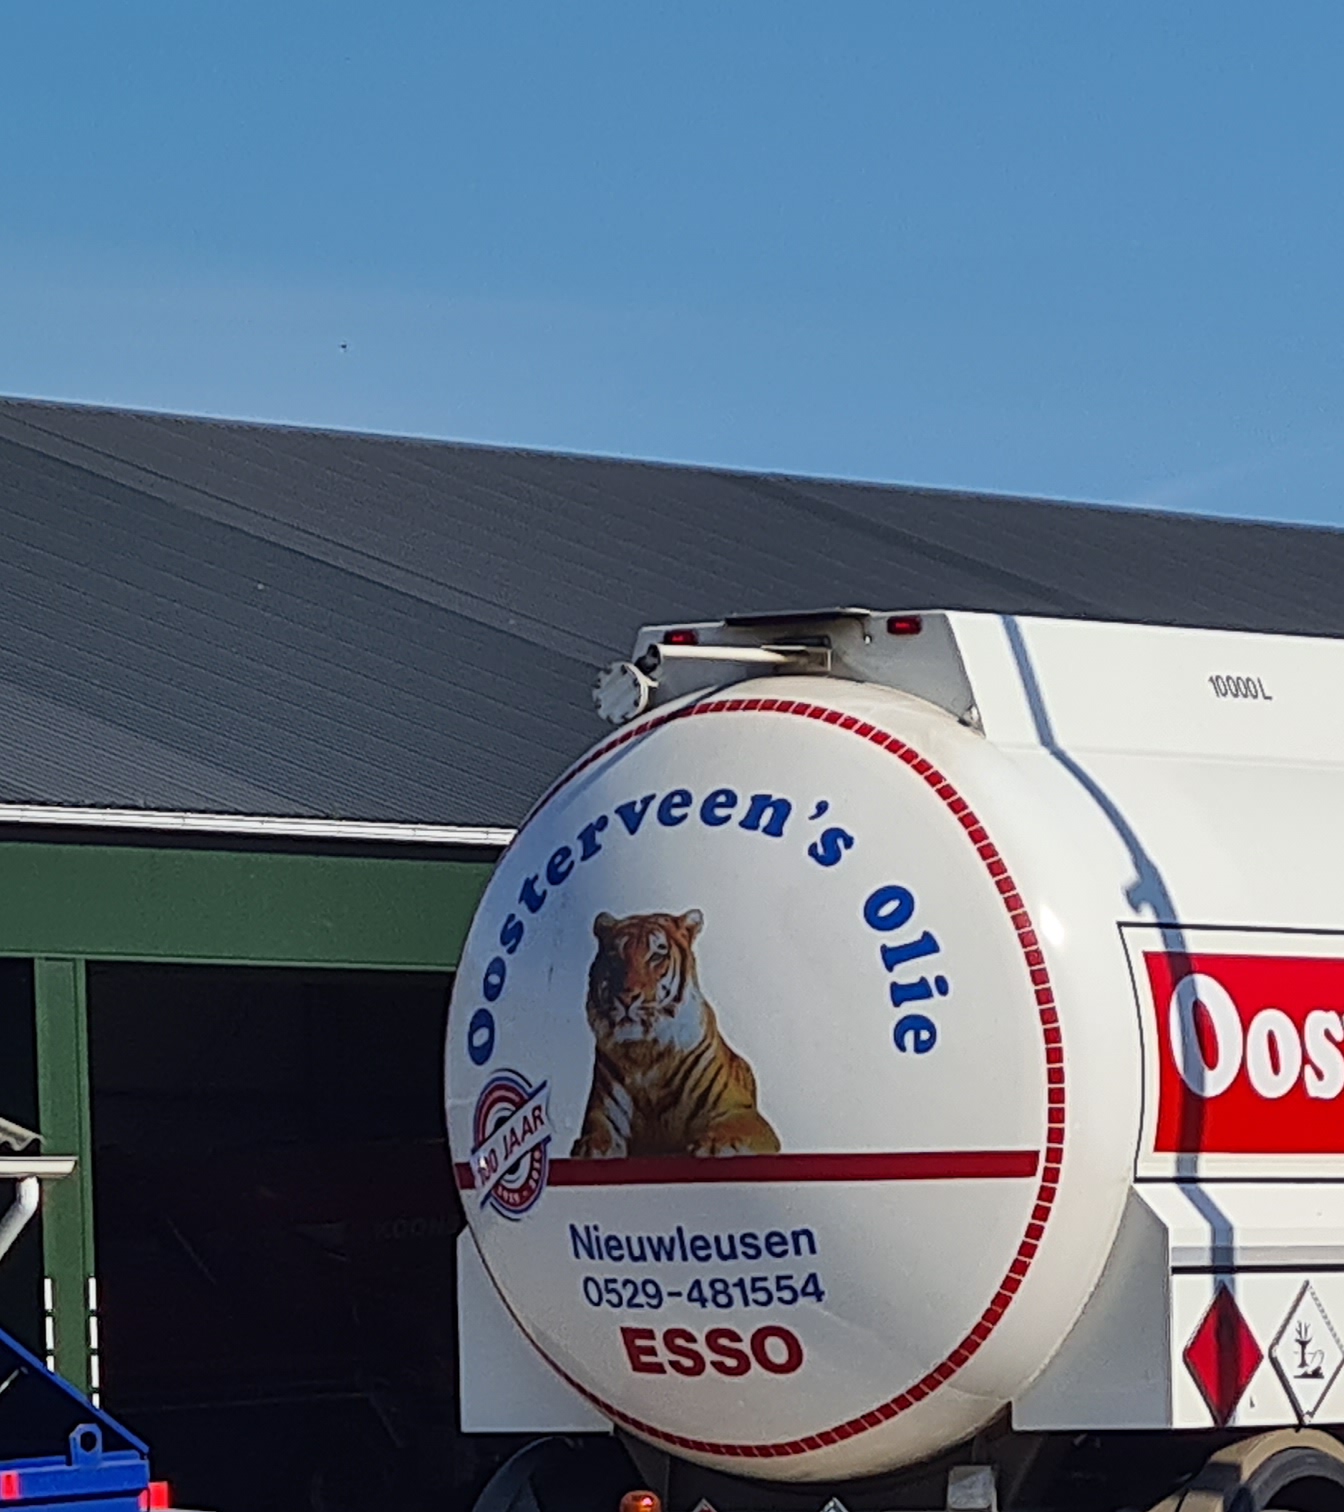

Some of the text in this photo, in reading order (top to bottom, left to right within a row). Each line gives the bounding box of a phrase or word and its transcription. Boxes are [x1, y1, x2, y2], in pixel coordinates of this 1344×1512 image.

[1208, 674, 1273, 701] 10000L
[468, 788, 854, 1066] Oosterveen's
[502, 1104, 545, 1161] JAAR
[568, 1223, 817, 1263] Nieuwleusen
[583, 1272, 826, 1310] 0529-481554
[620, 1325, 804, 1377] ESSO
